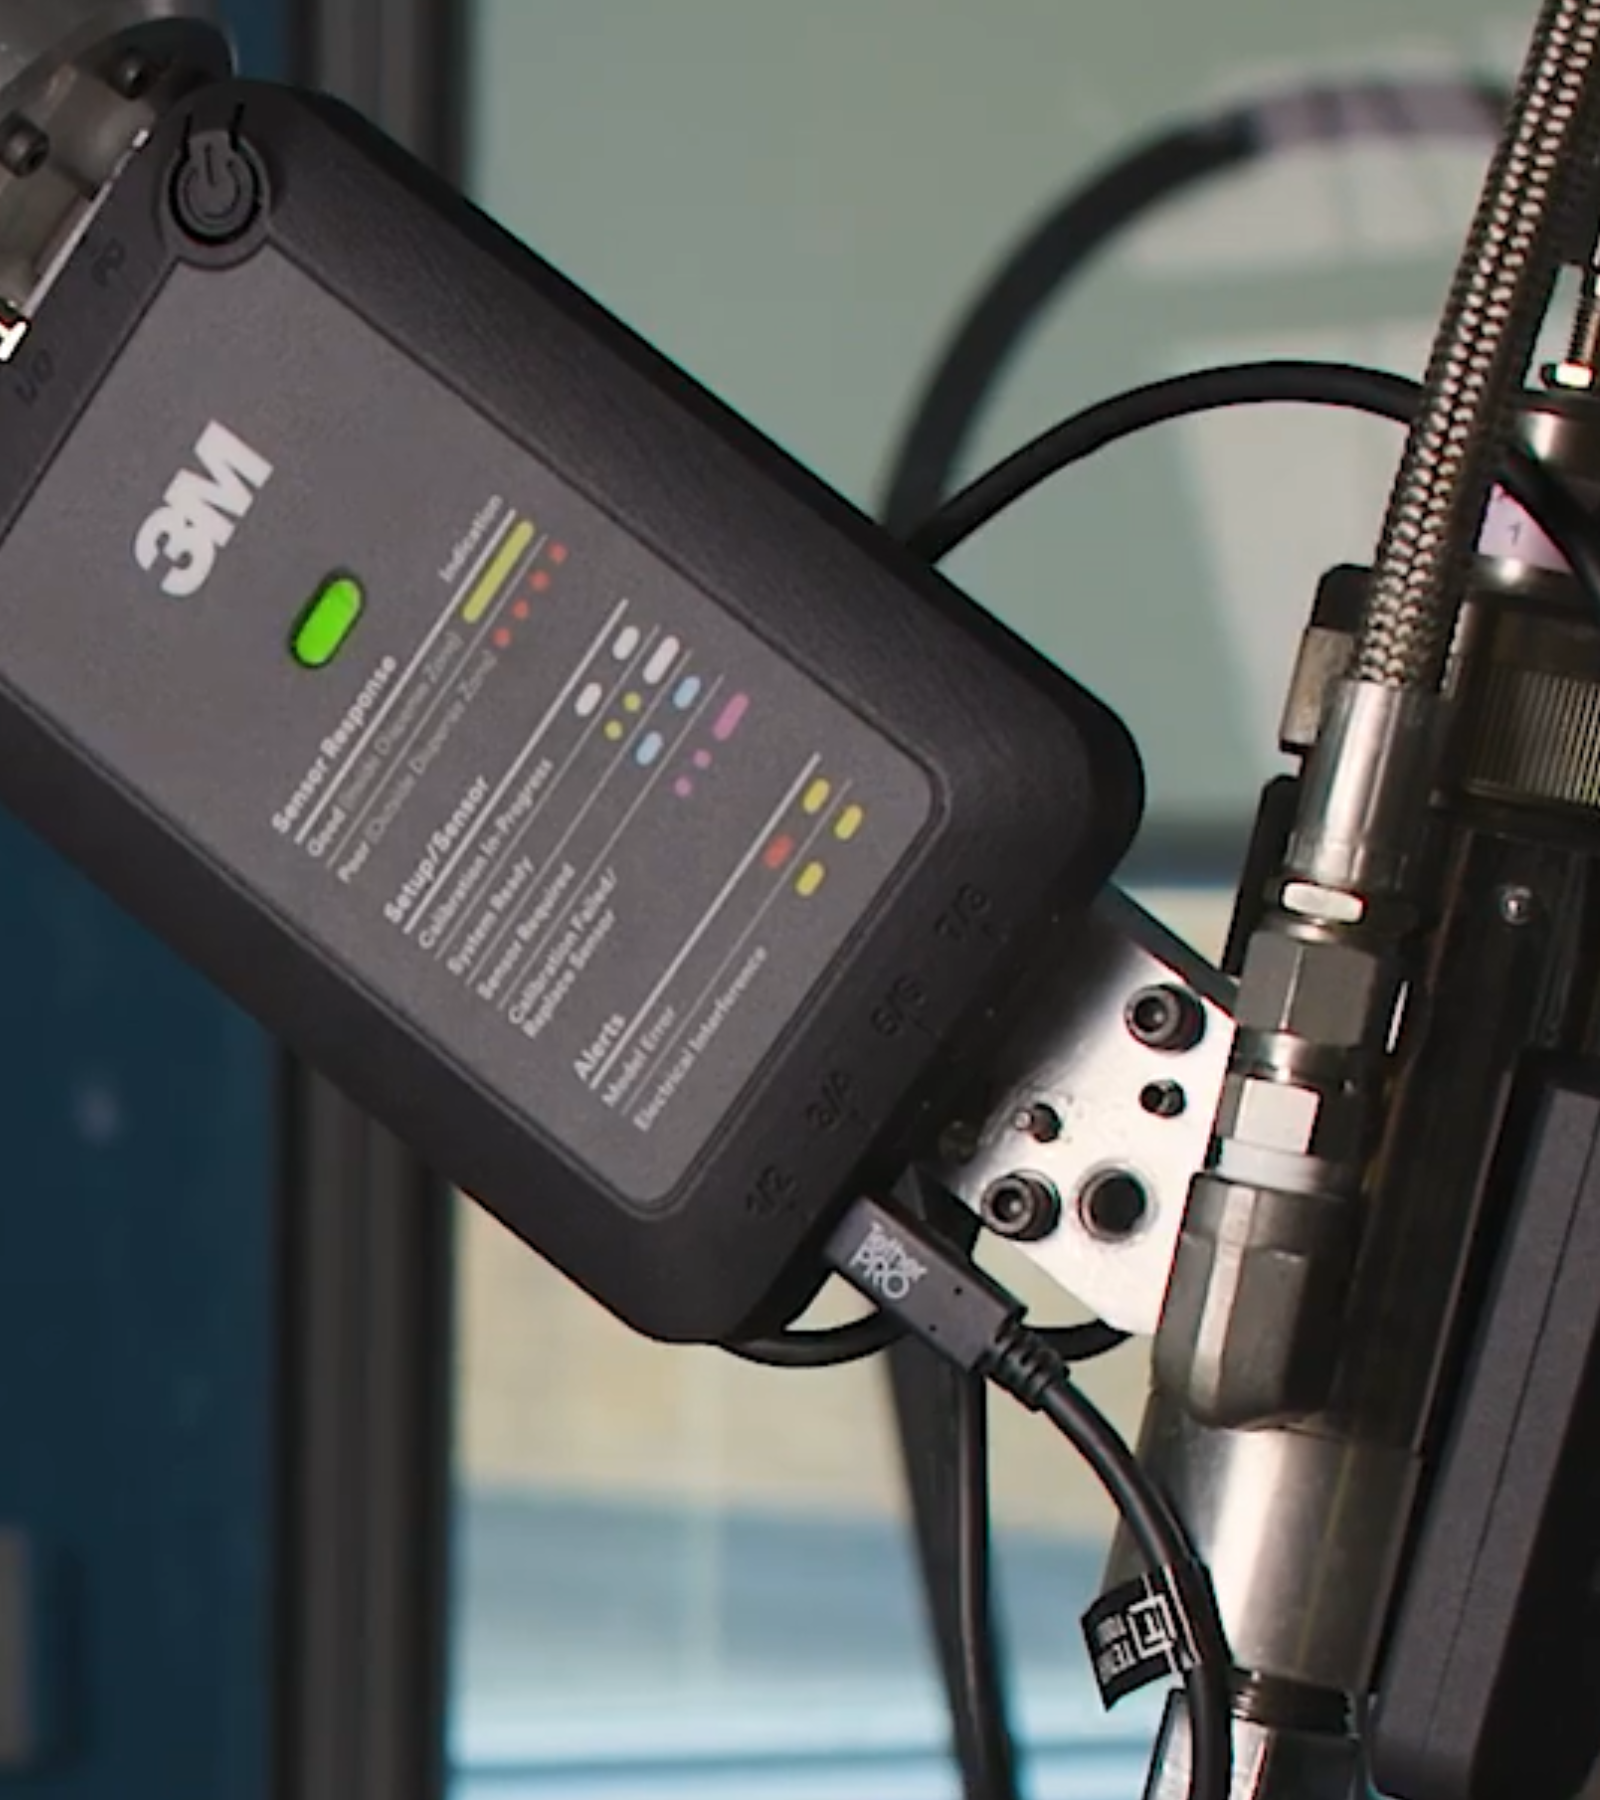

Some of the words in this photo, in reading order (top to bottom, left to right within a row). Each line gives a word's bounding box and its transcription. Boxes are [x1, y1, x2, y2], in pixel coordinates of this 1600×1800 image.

[135, 421, 272, 594] 3M
[438, 495, 501, 582] Indication
[271, 757, 327, 833] Sensor
[320, 656, 396, 758] Response
[307, 806, 345, 856] Good
[383, 775, 487, 922] Setup/Sensor
[418, 855, 486, 948] Calibration
[479, 758, 552, 856] In-Progress
[447, 911, 496, 974] System
[489, 856, 533, 910] Ready
[477, 939, 522, 999] Sensor
[516, 863, 574, 940] Required
[522, 970, 574, 1037] Replace
[568, 909, 614, 969] Sensor
[508, 931, 577, 1023] Calibration
[574, 1014, 624, 1080] Alerts
[601, 1048, 646, 1106] Model
[640, 1006, 674, 1051] Error
[633, 1049, 694, 1130] Electrical
[687, 946, 766, 1051] Interference
[849, 1246, 906, 1298] PRO
[865, 1220, 928, 1280] Tether
